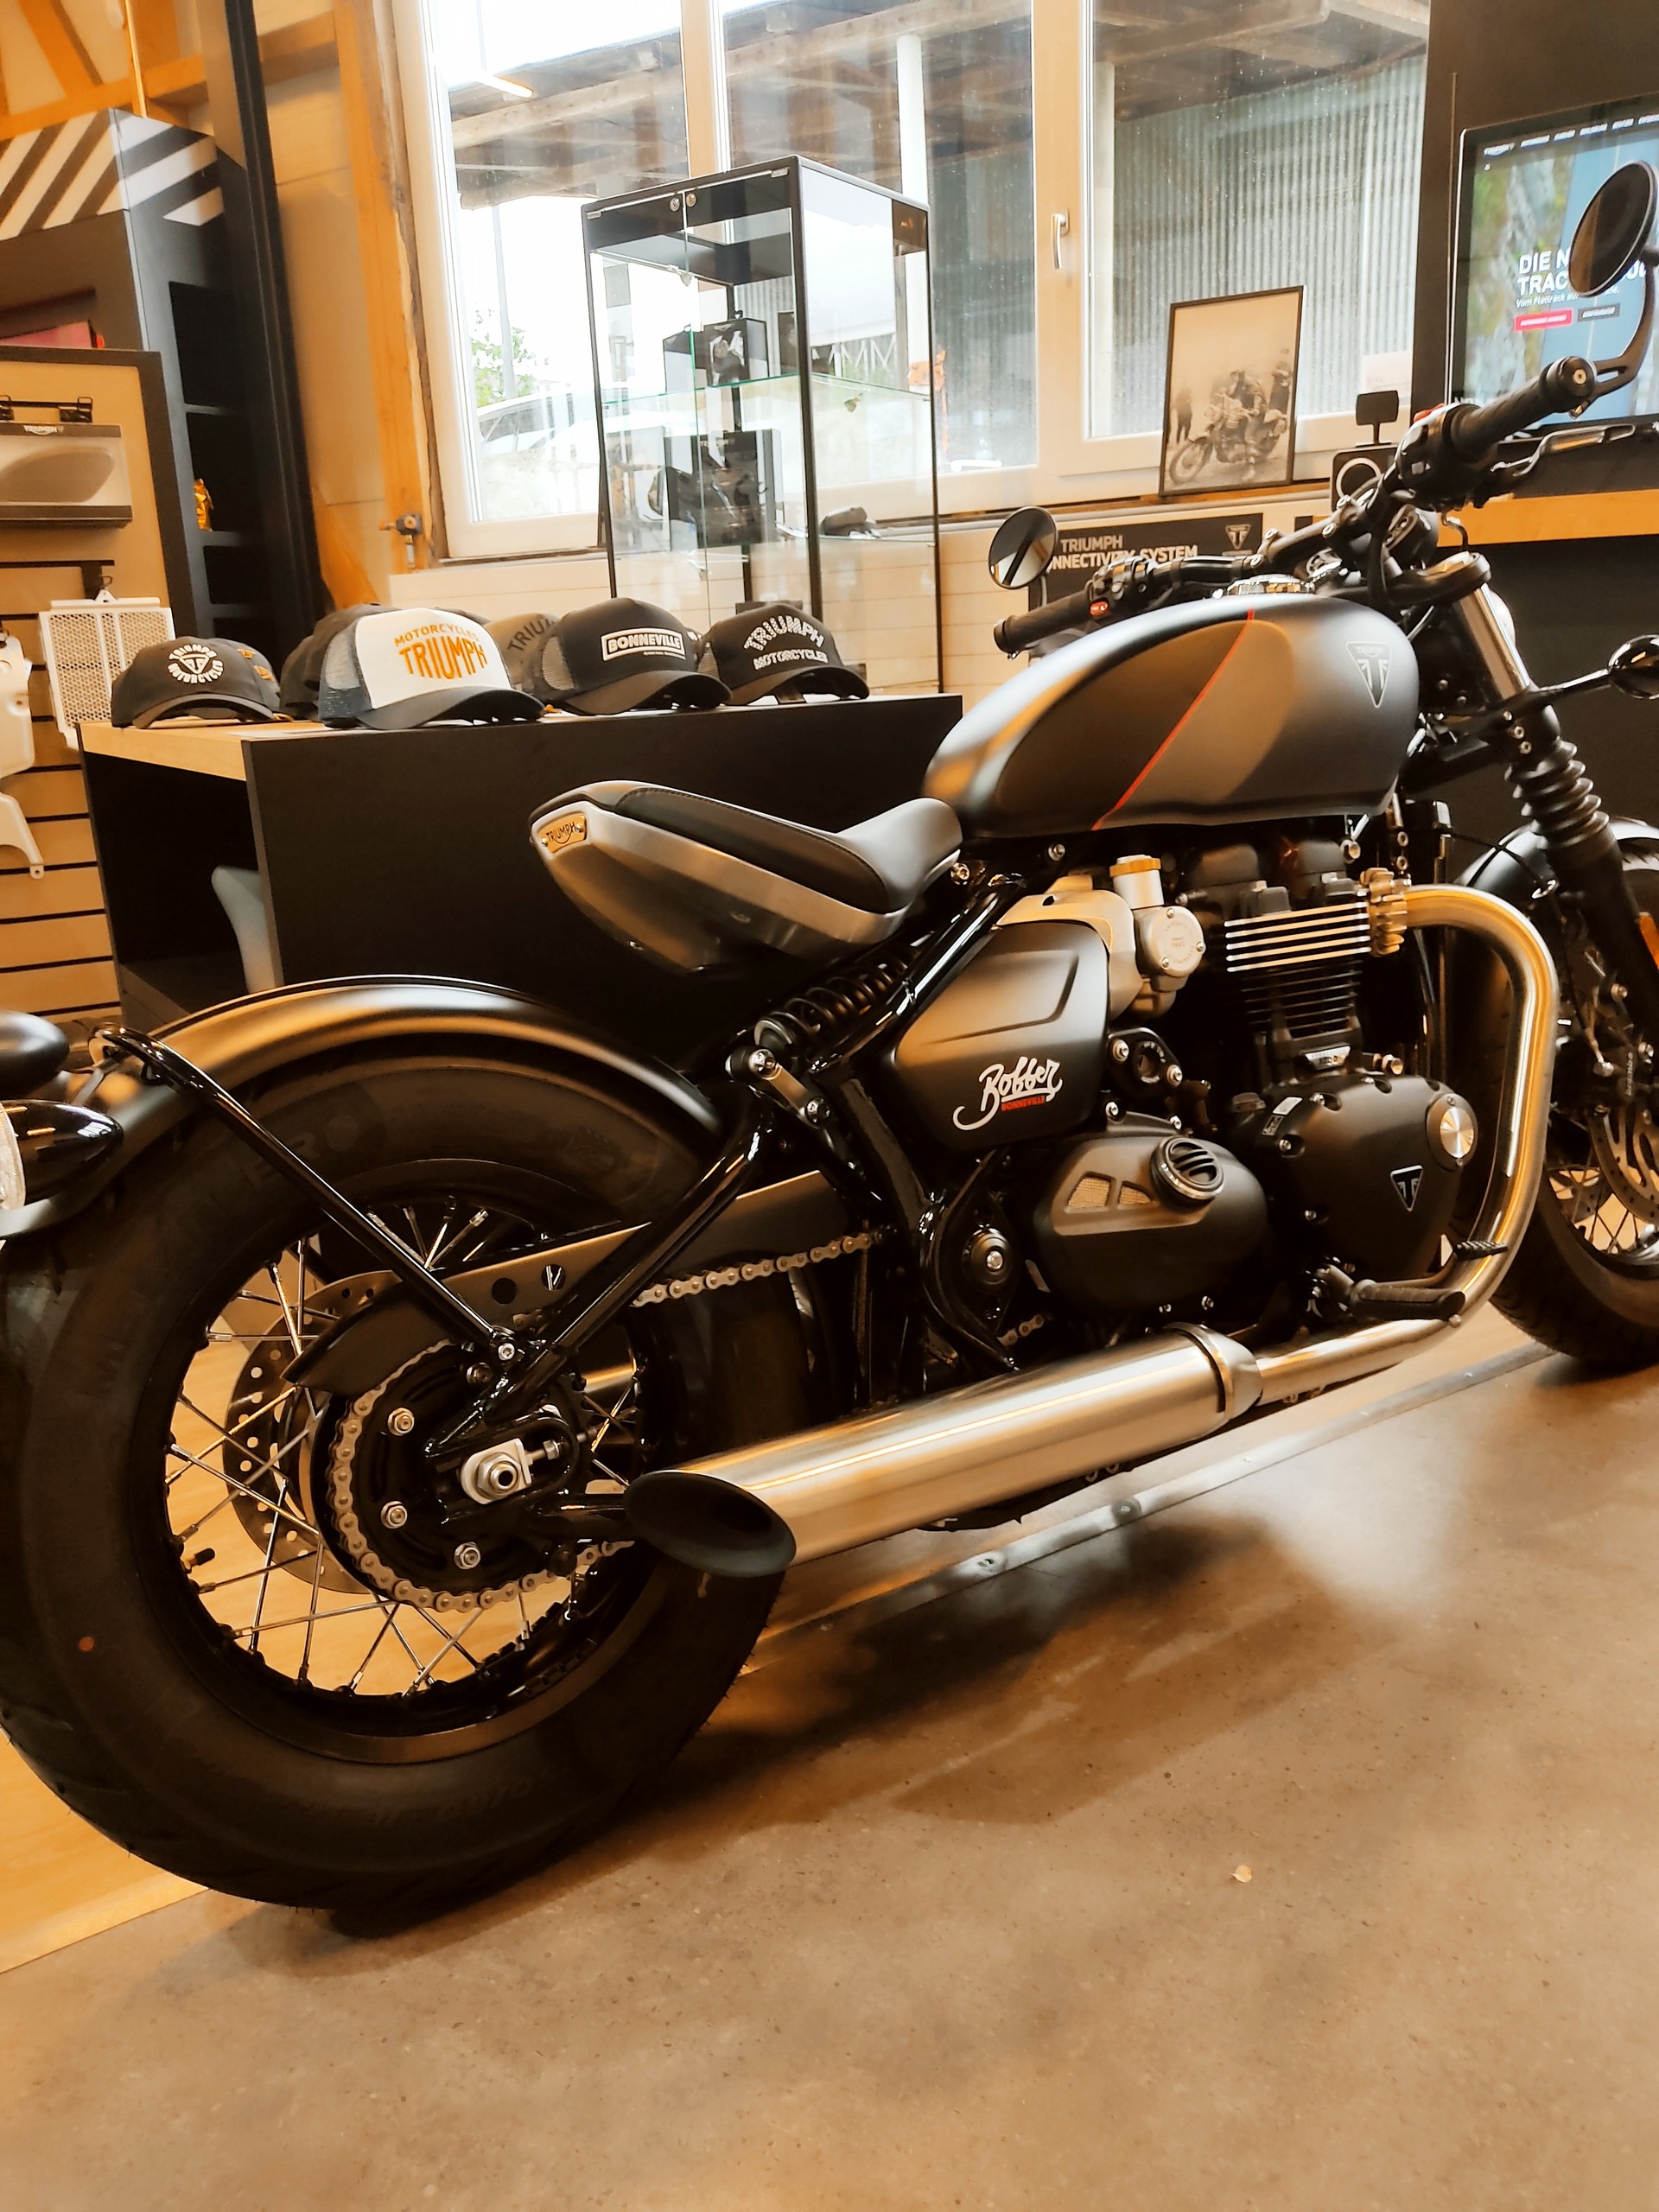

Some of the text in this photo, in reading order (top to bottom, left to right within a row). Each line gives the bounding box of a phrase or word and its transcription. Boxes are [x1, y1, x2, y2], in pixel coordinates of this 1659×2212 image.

[1519, 250, 1552, 274] DIE
[1517, 270, 1569, 296] TRAC
[1059, 534, 1123, 554] TRIUMPH
[1139, 544, 1199, 563] SYSTEM
[393, 622, 480, 647] MOTORCYCLES
[607, 633, 681, 653] BONNEVILLE
[743, 614, 824, 652] TRIUMPH
[398, 635, 488, 680] TRIUMPH
[545, 822, 578, 844] TRIUMPH
[952, 1056, 1064, 1131] Bobber
